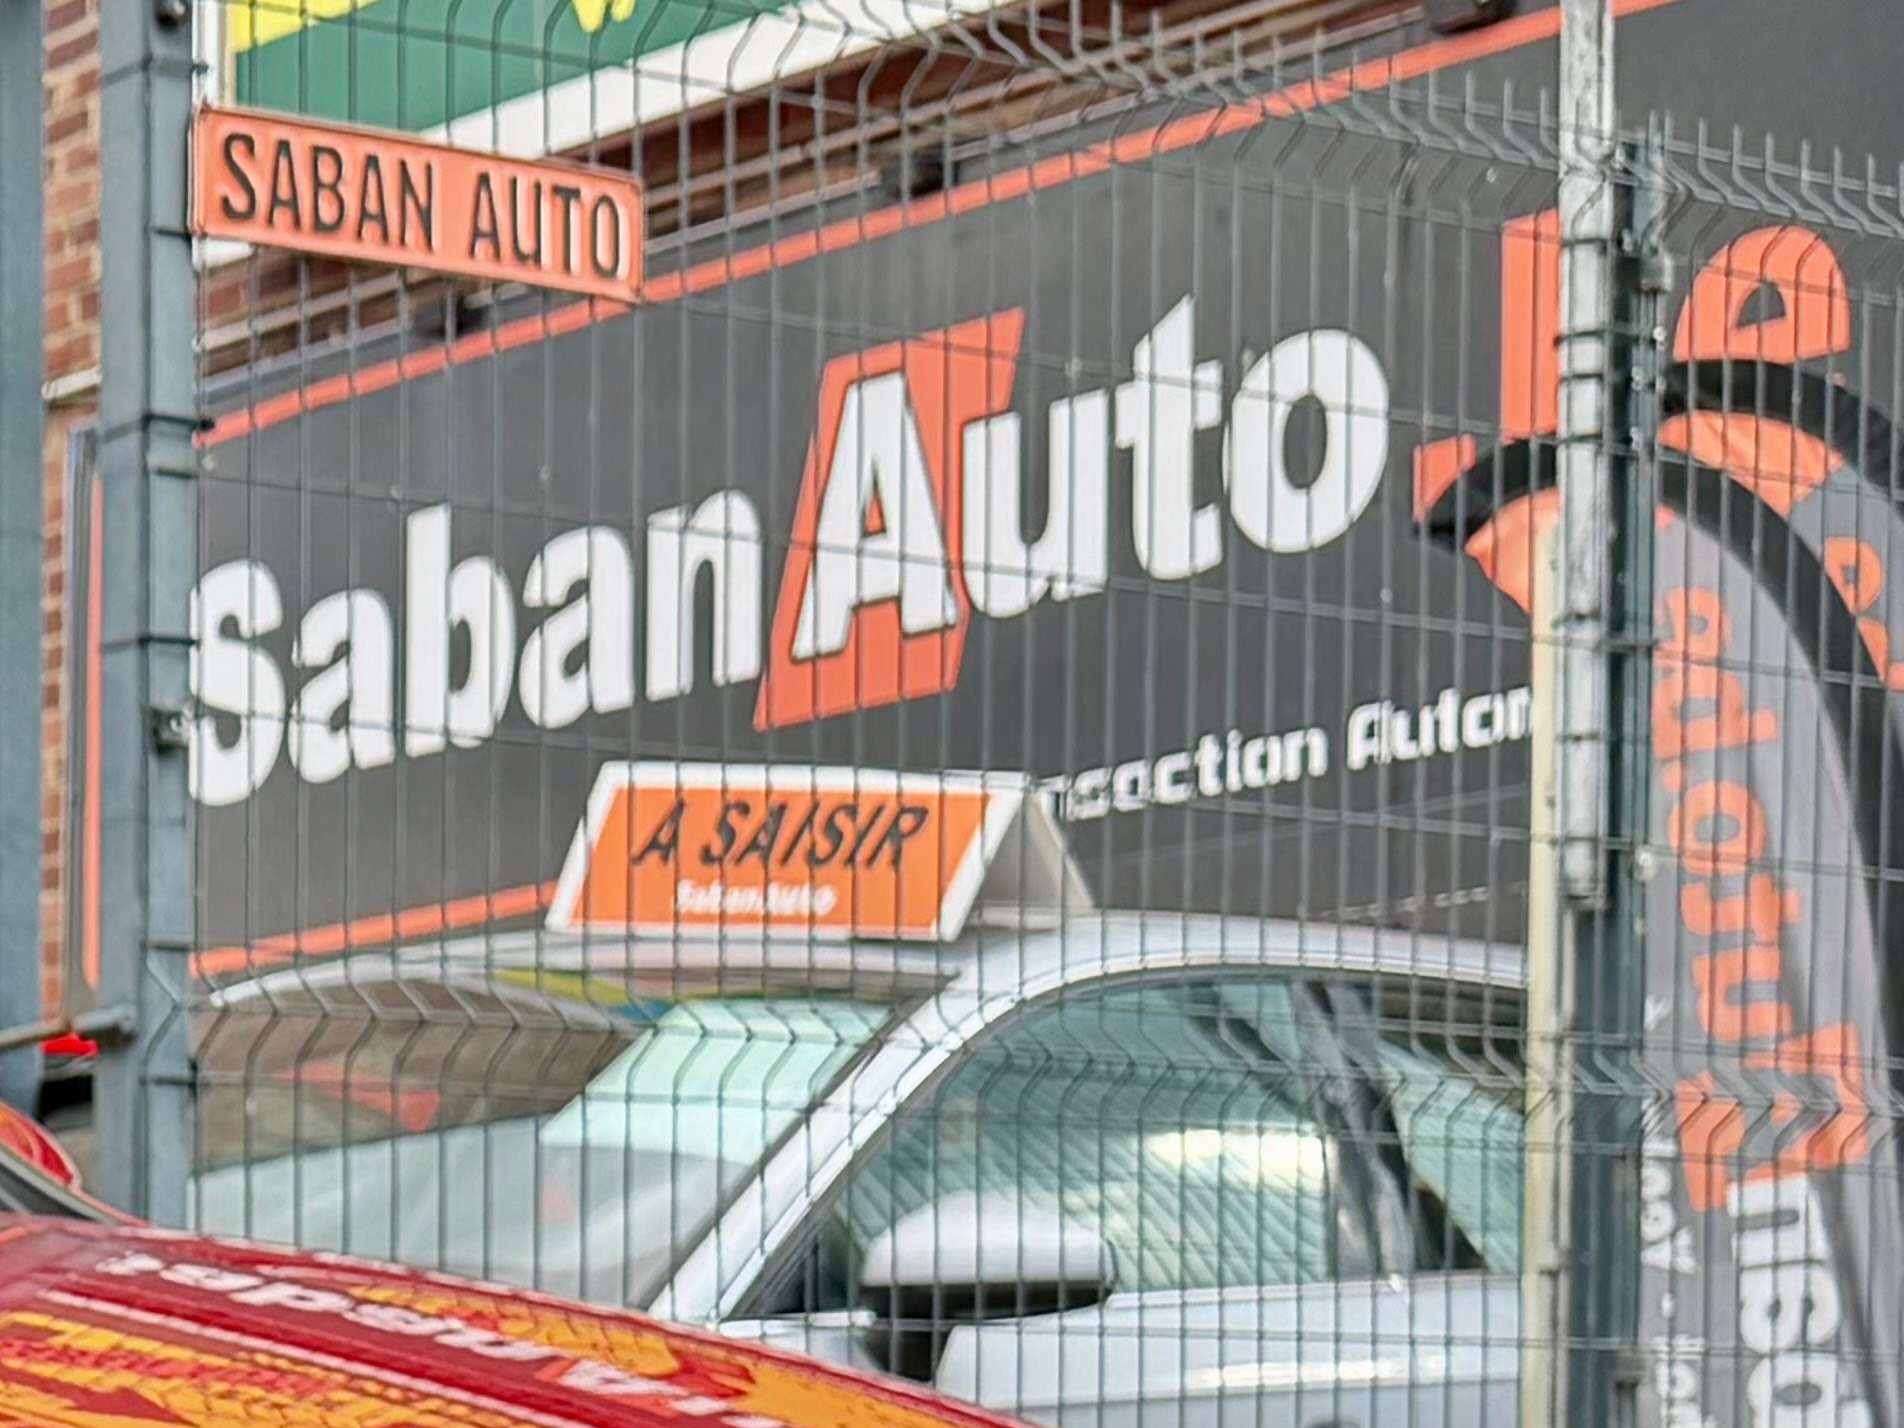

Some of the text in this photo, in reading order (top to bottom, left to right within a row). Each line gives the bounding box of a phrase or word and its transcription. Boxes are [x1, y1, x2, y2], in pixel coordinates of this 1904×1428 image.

[220, 131, 623, 279] SABAN AUTO
[1037, 726, 1329, 822] nsaction
[700, 799, 930, 872] SAISIR
